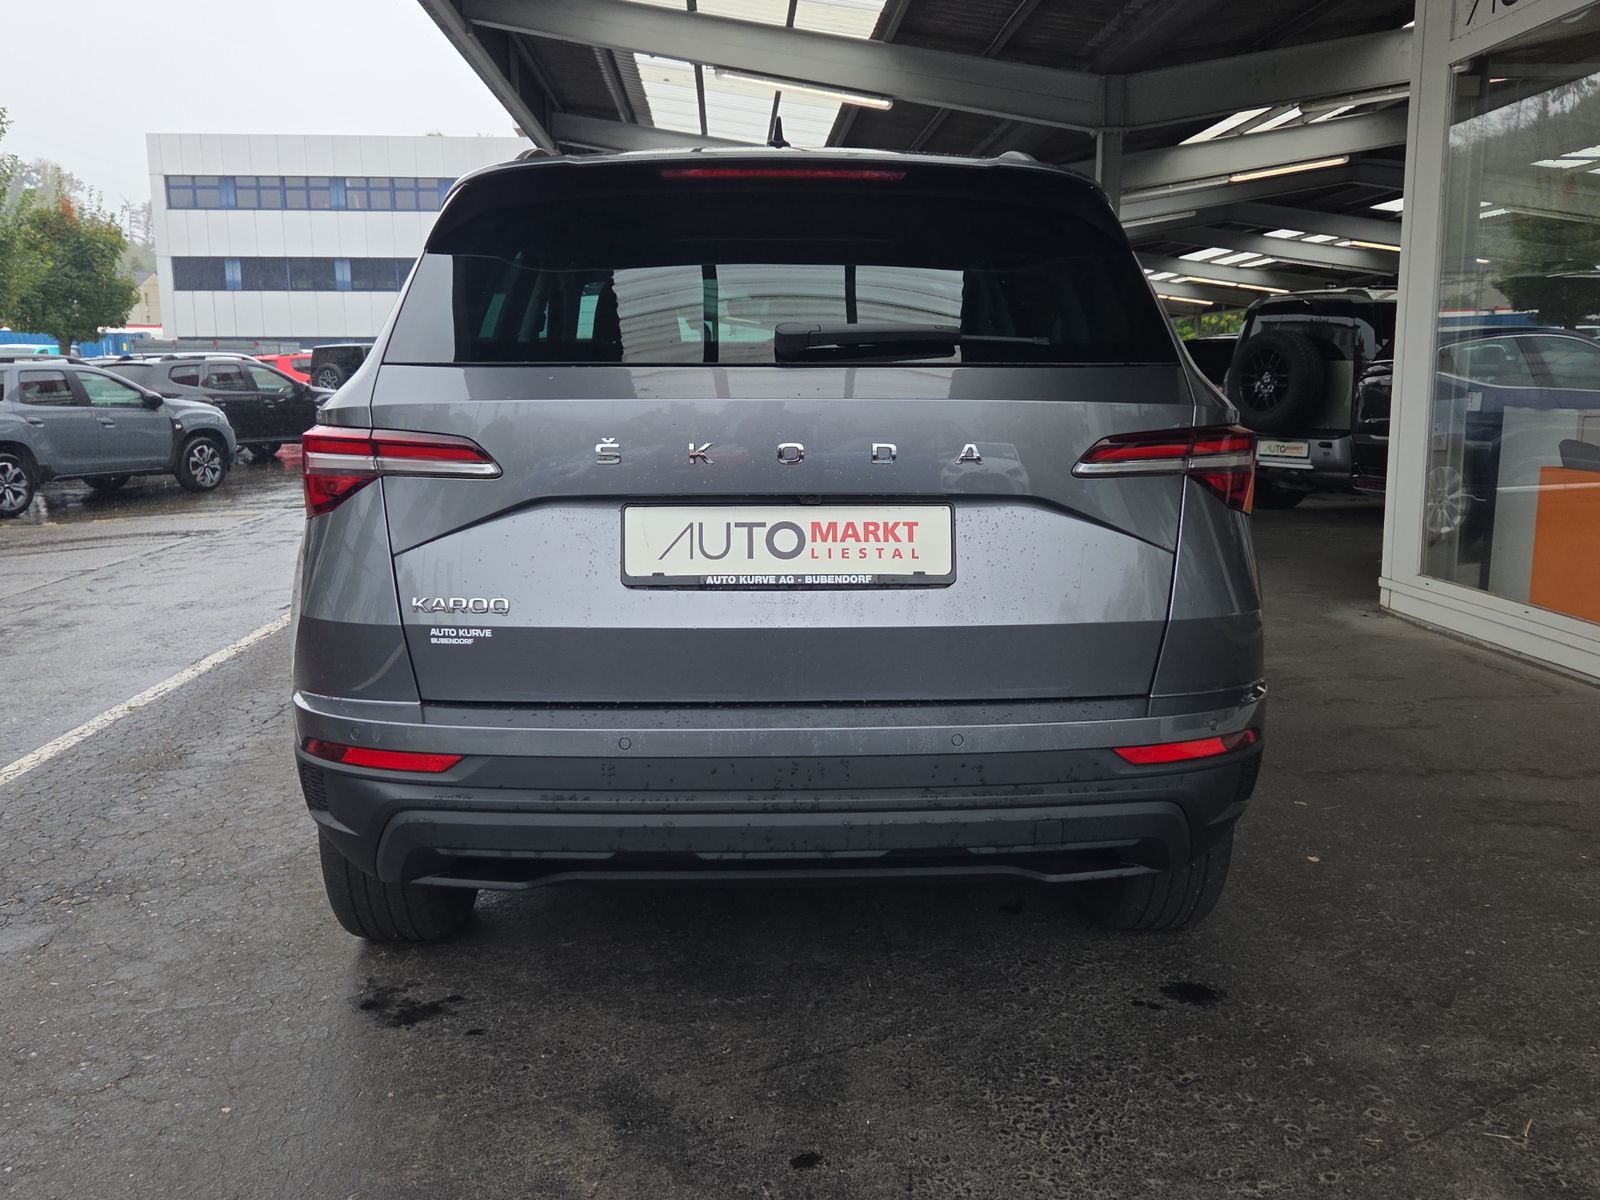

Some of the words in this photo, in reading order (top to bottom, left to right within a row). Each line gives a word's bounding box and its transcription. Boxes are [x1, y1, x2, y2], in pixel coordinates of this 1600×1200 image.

[595, 437, 983, 465] ŠKODA
[658, 520, 806, 561] AUTO
[811, 521, 919, 543] MARKT
[811, 547, 919, 560] LIESTAL
[706, 575, 737, 584] AUTO
[739, 575, 777, 584] KURVE
[779, 575, 795, 584] AG
[805, 575, 872, 585] BUBENDORF
[412, 597, 511, 616] KAROQ
[430, 628, 457, 637] AUTO
[458, 628, 492, 637] KURVE
[430, 637, 474, 645] BUBENDORF
